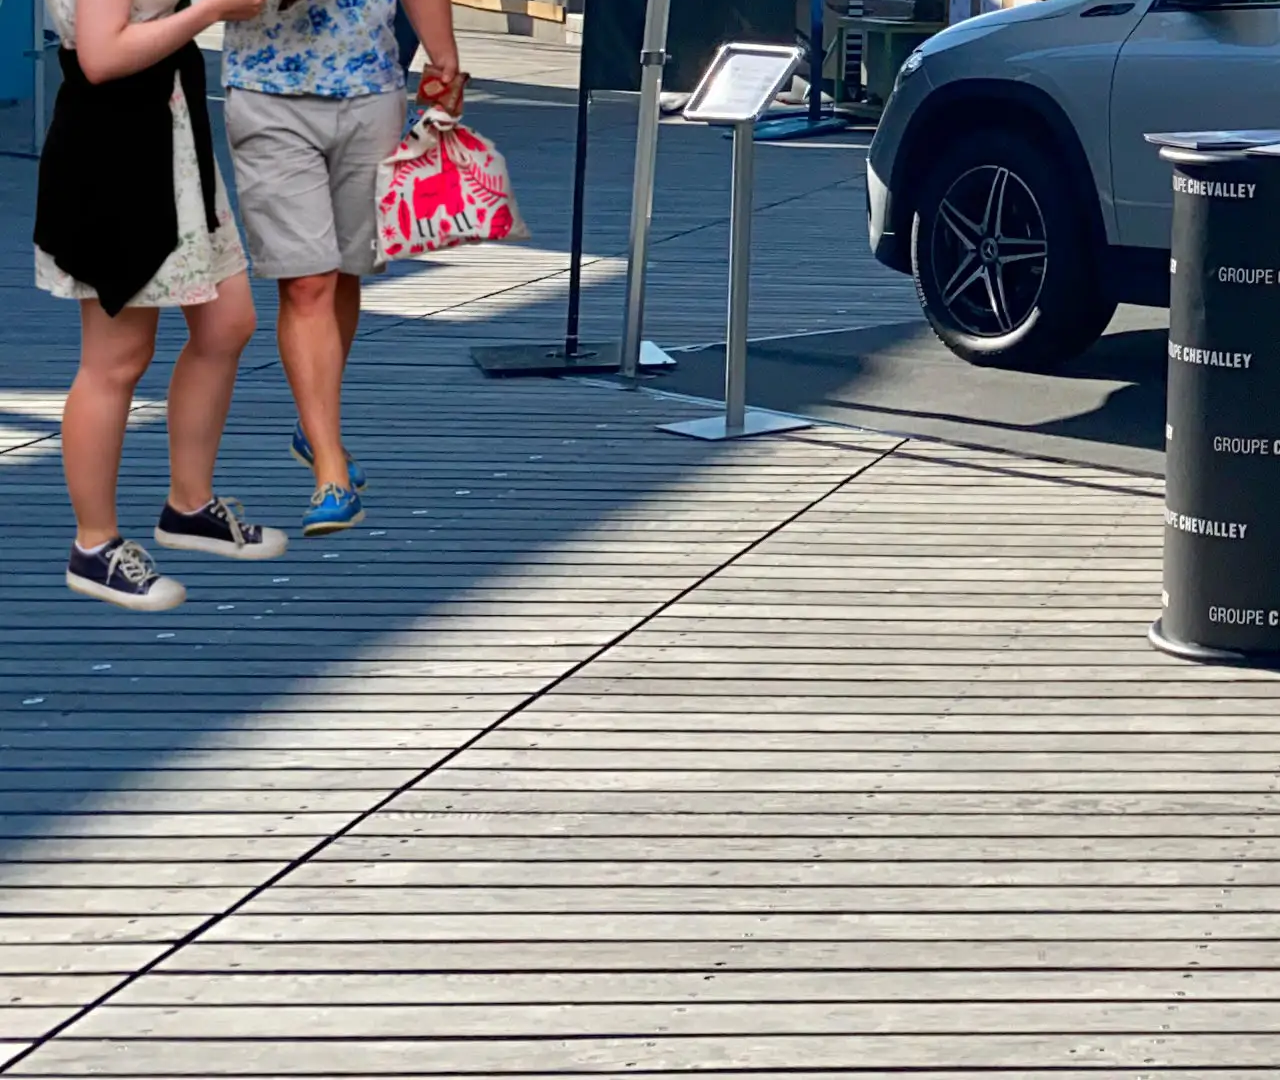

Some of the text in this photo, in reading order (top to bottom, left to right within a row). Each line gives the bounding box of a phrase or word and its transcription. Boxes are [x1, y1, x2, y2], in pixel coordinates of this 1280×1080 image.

[1187, 178, 1257, 199] CHEVALLEY
[1218, 266, 1273, 285] GROUPE
[1183, 346, 1253, 369] CHEVALLEY
[1213, 436, 1269, 456] GROUPE
[1179, 514, 1248, 539] CHEVALLEY
[1208, 605, 1264, 626] GROUPE
